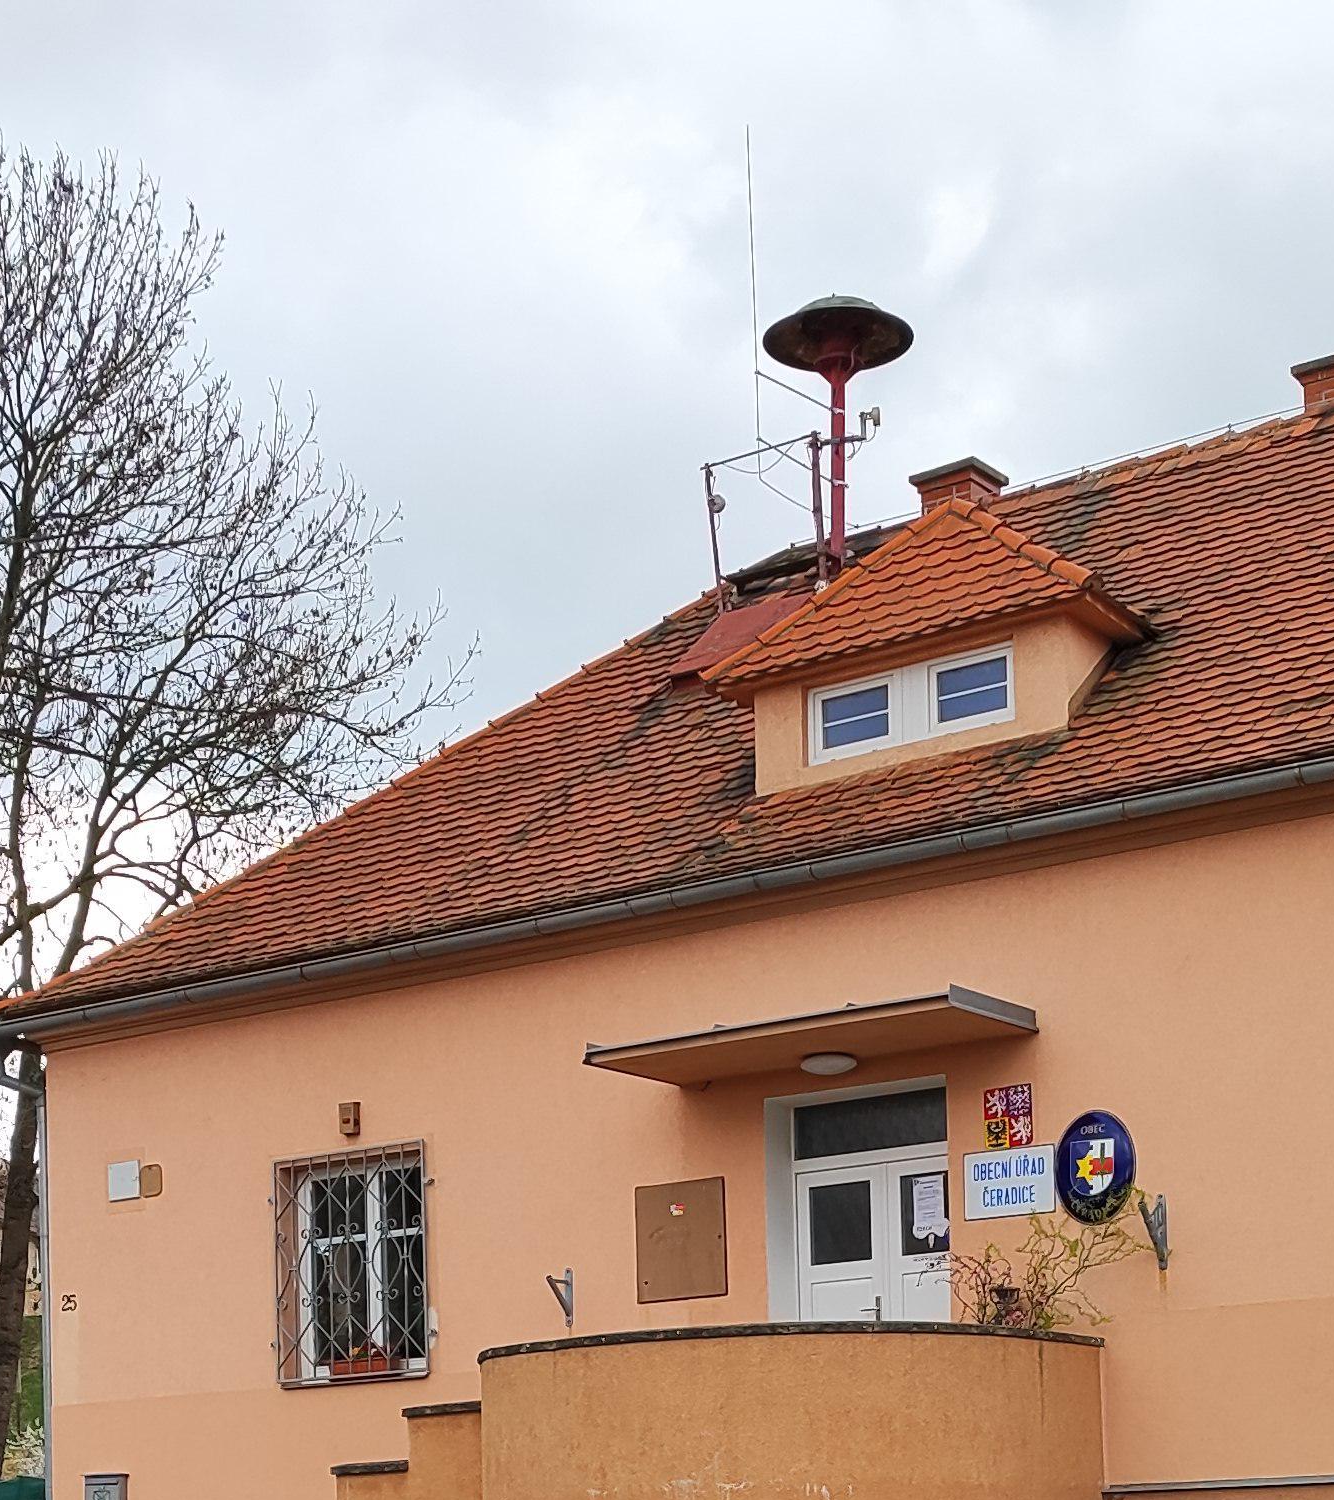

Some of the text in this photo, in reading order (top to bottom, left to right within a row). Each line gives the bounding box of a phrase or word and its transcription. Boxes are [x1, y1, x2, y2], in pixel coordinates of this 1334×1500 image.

[1080, 1124, 1105, 1135] OBEC
[973, 1153, 1045, 1182] OBECNÍ ÚŘAD
[982, 1185, 1036, 1207] ČERADICE
[61, 1294, 78, 1312] 25
